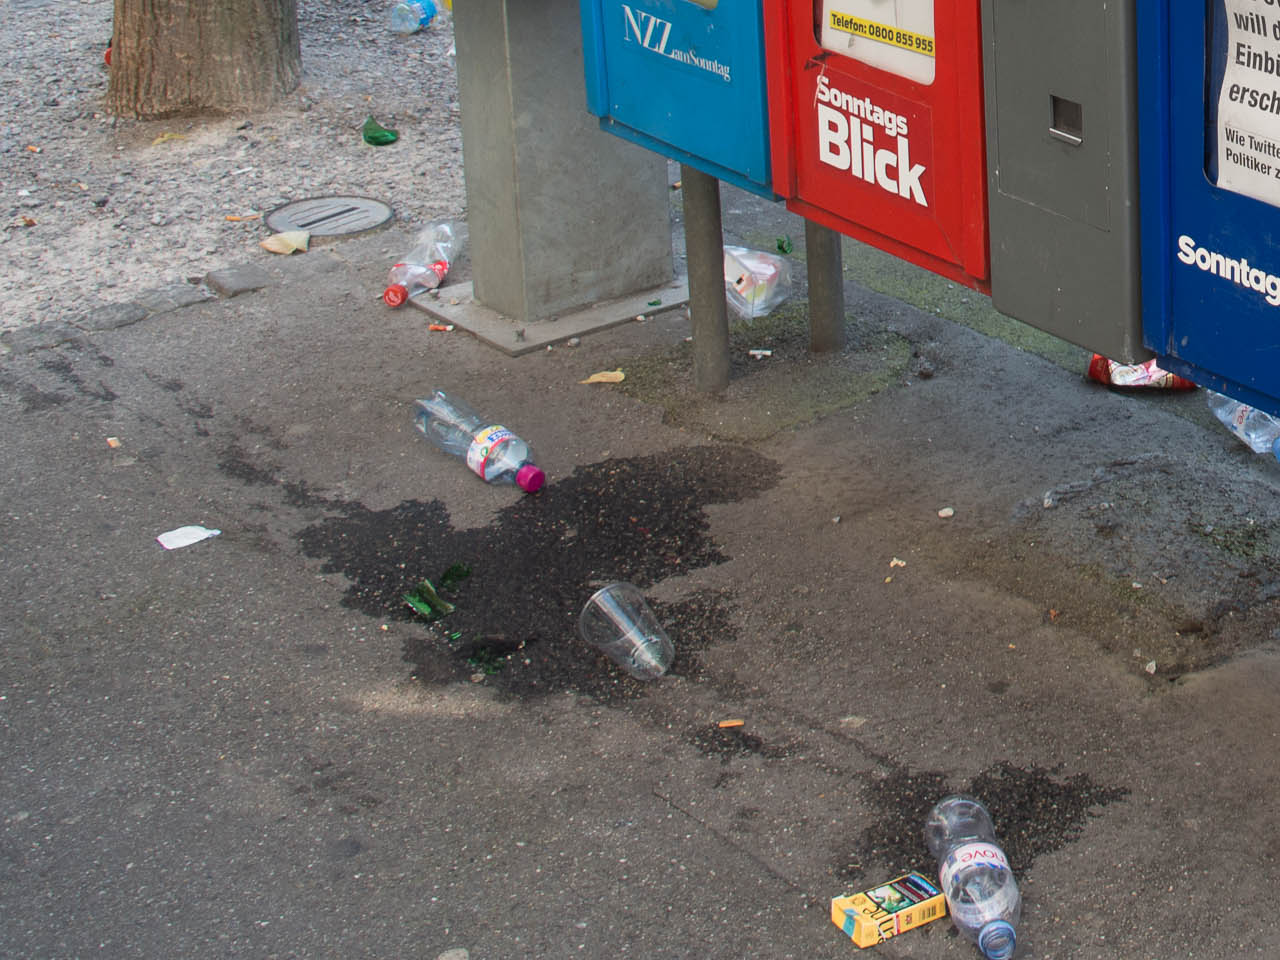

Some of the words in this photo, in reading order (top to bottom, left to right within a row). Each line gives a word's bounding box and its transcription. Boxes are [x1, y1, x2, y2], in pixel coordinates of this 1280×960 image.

[621, 3, 674, 58] NZZ
[831, 13, 867, 34] Telefon:
[868, 24, 894, 42] 0800
[895, 31, 914, 47] 855
[914, 37, 934, 53] 955
[1233, 11, 1268, 38] will
[816, 74, 909, 137] Sonntags
[817, 101, 929, 208] Blick
[1225, 127, 1246, 147] Wie
[1225, 146, 1273, 176] Politiker
